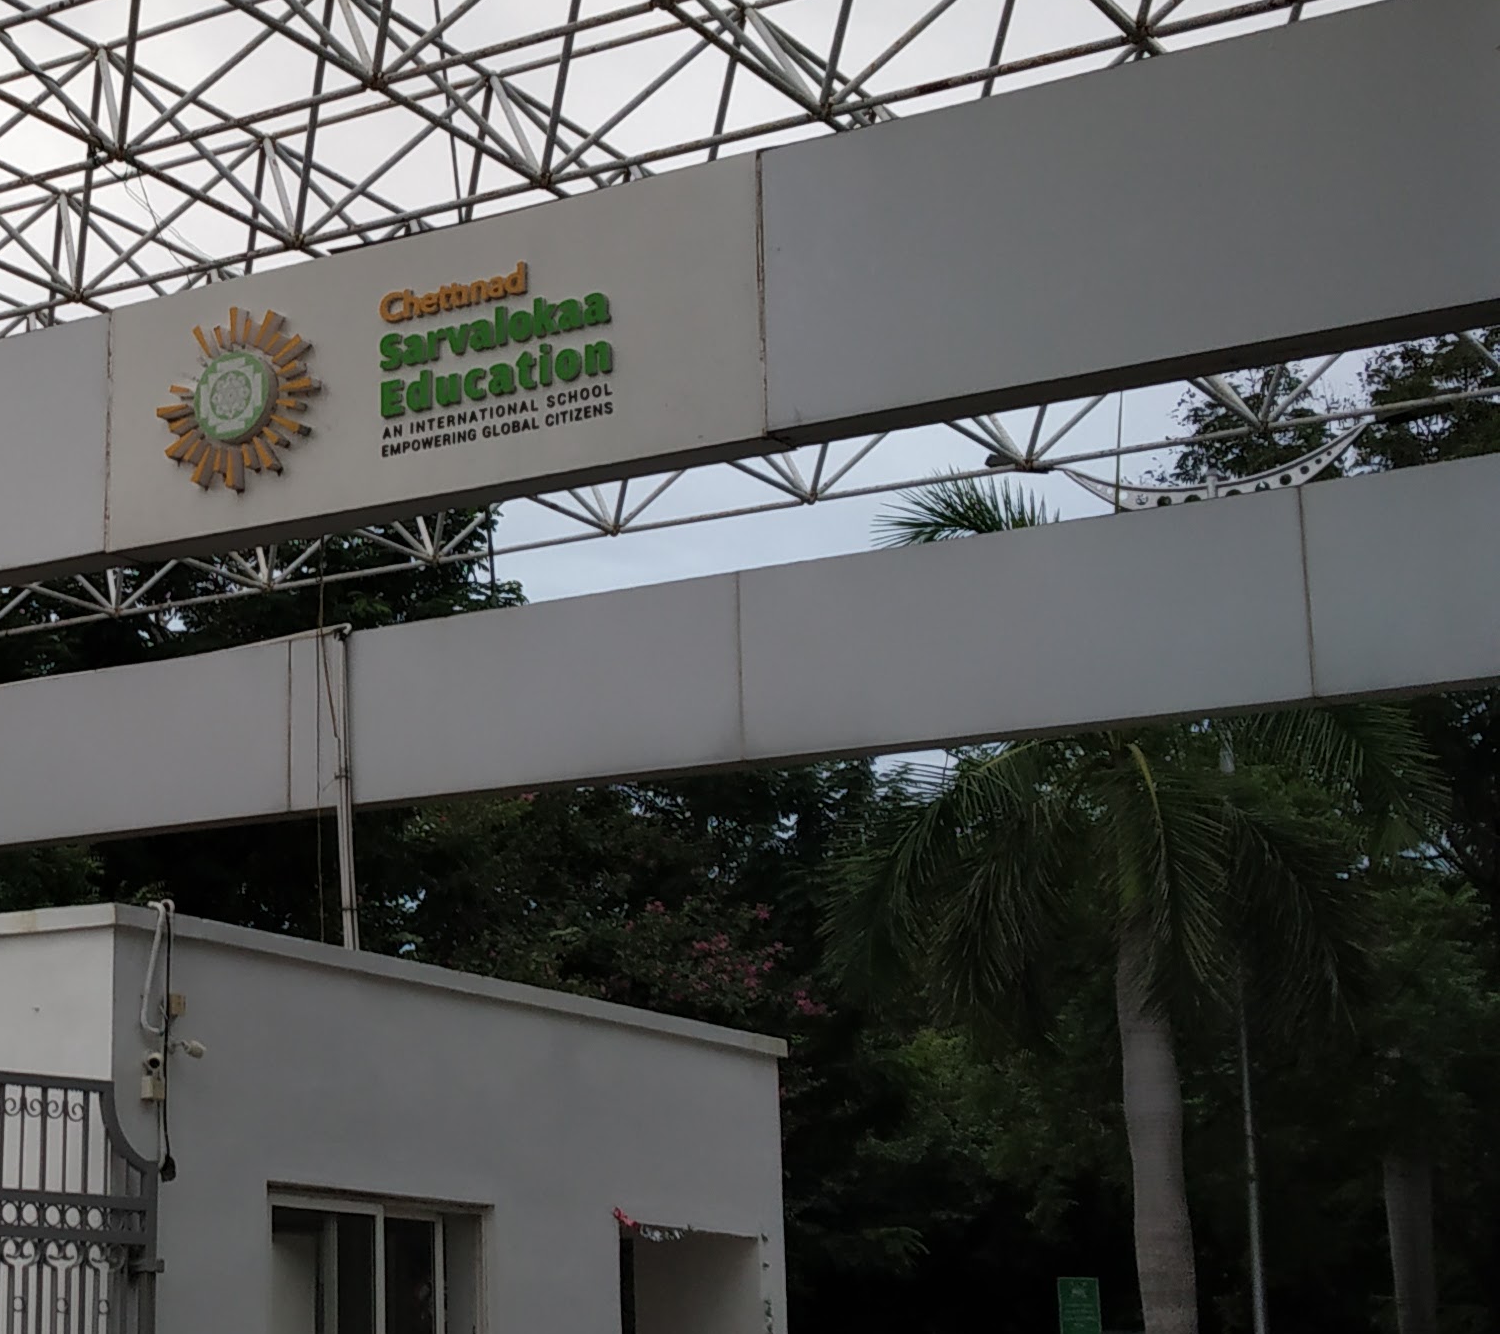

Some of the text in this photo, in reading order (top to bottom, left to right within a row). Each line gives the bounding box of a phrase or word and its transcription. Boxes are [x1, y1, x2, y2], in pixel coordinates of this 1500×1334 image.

[379, 261, 528, 324] Chettinad
[379, 292, 612, 371] Sarvalokaa
[380, 340, 613, 419] Education
[381, 401, 614, 458] EMPOWERING GLOBAL CITIZENS
[382, 383, 613, 440] AN INTERNATIONAL SCHOOL
